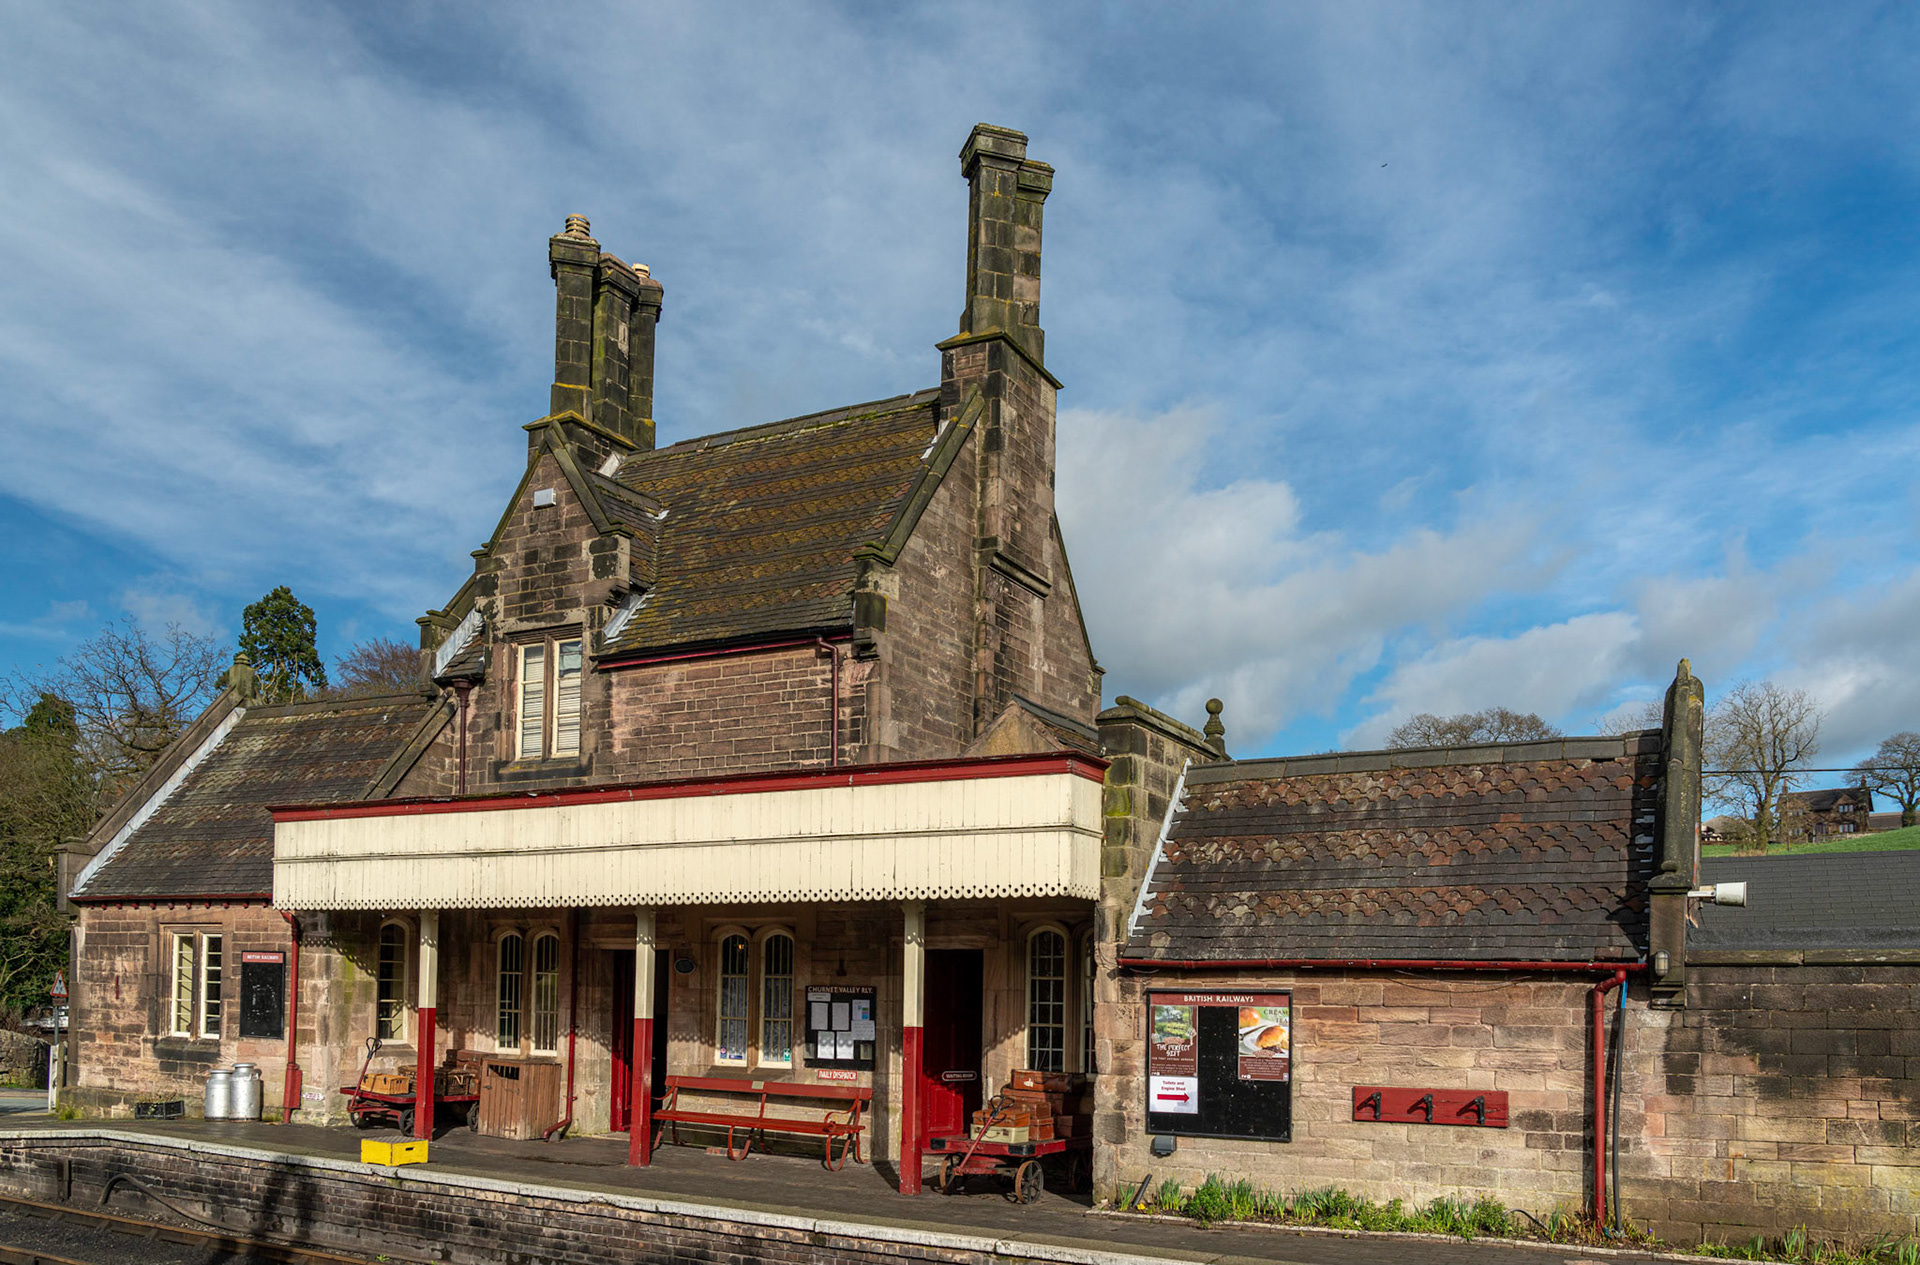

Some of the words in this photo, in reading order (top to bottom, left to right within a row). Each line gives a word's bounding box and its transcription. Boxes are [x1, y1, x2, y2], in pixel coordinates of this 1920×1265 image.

[1183, 995, 1213, 1003] BRITISH
[1216, 995, 1254, 1003] RAILWAYS
[819, 1070, 832, 1078] DAILY
[832, 1071, 857, 1080] DISPATCH
